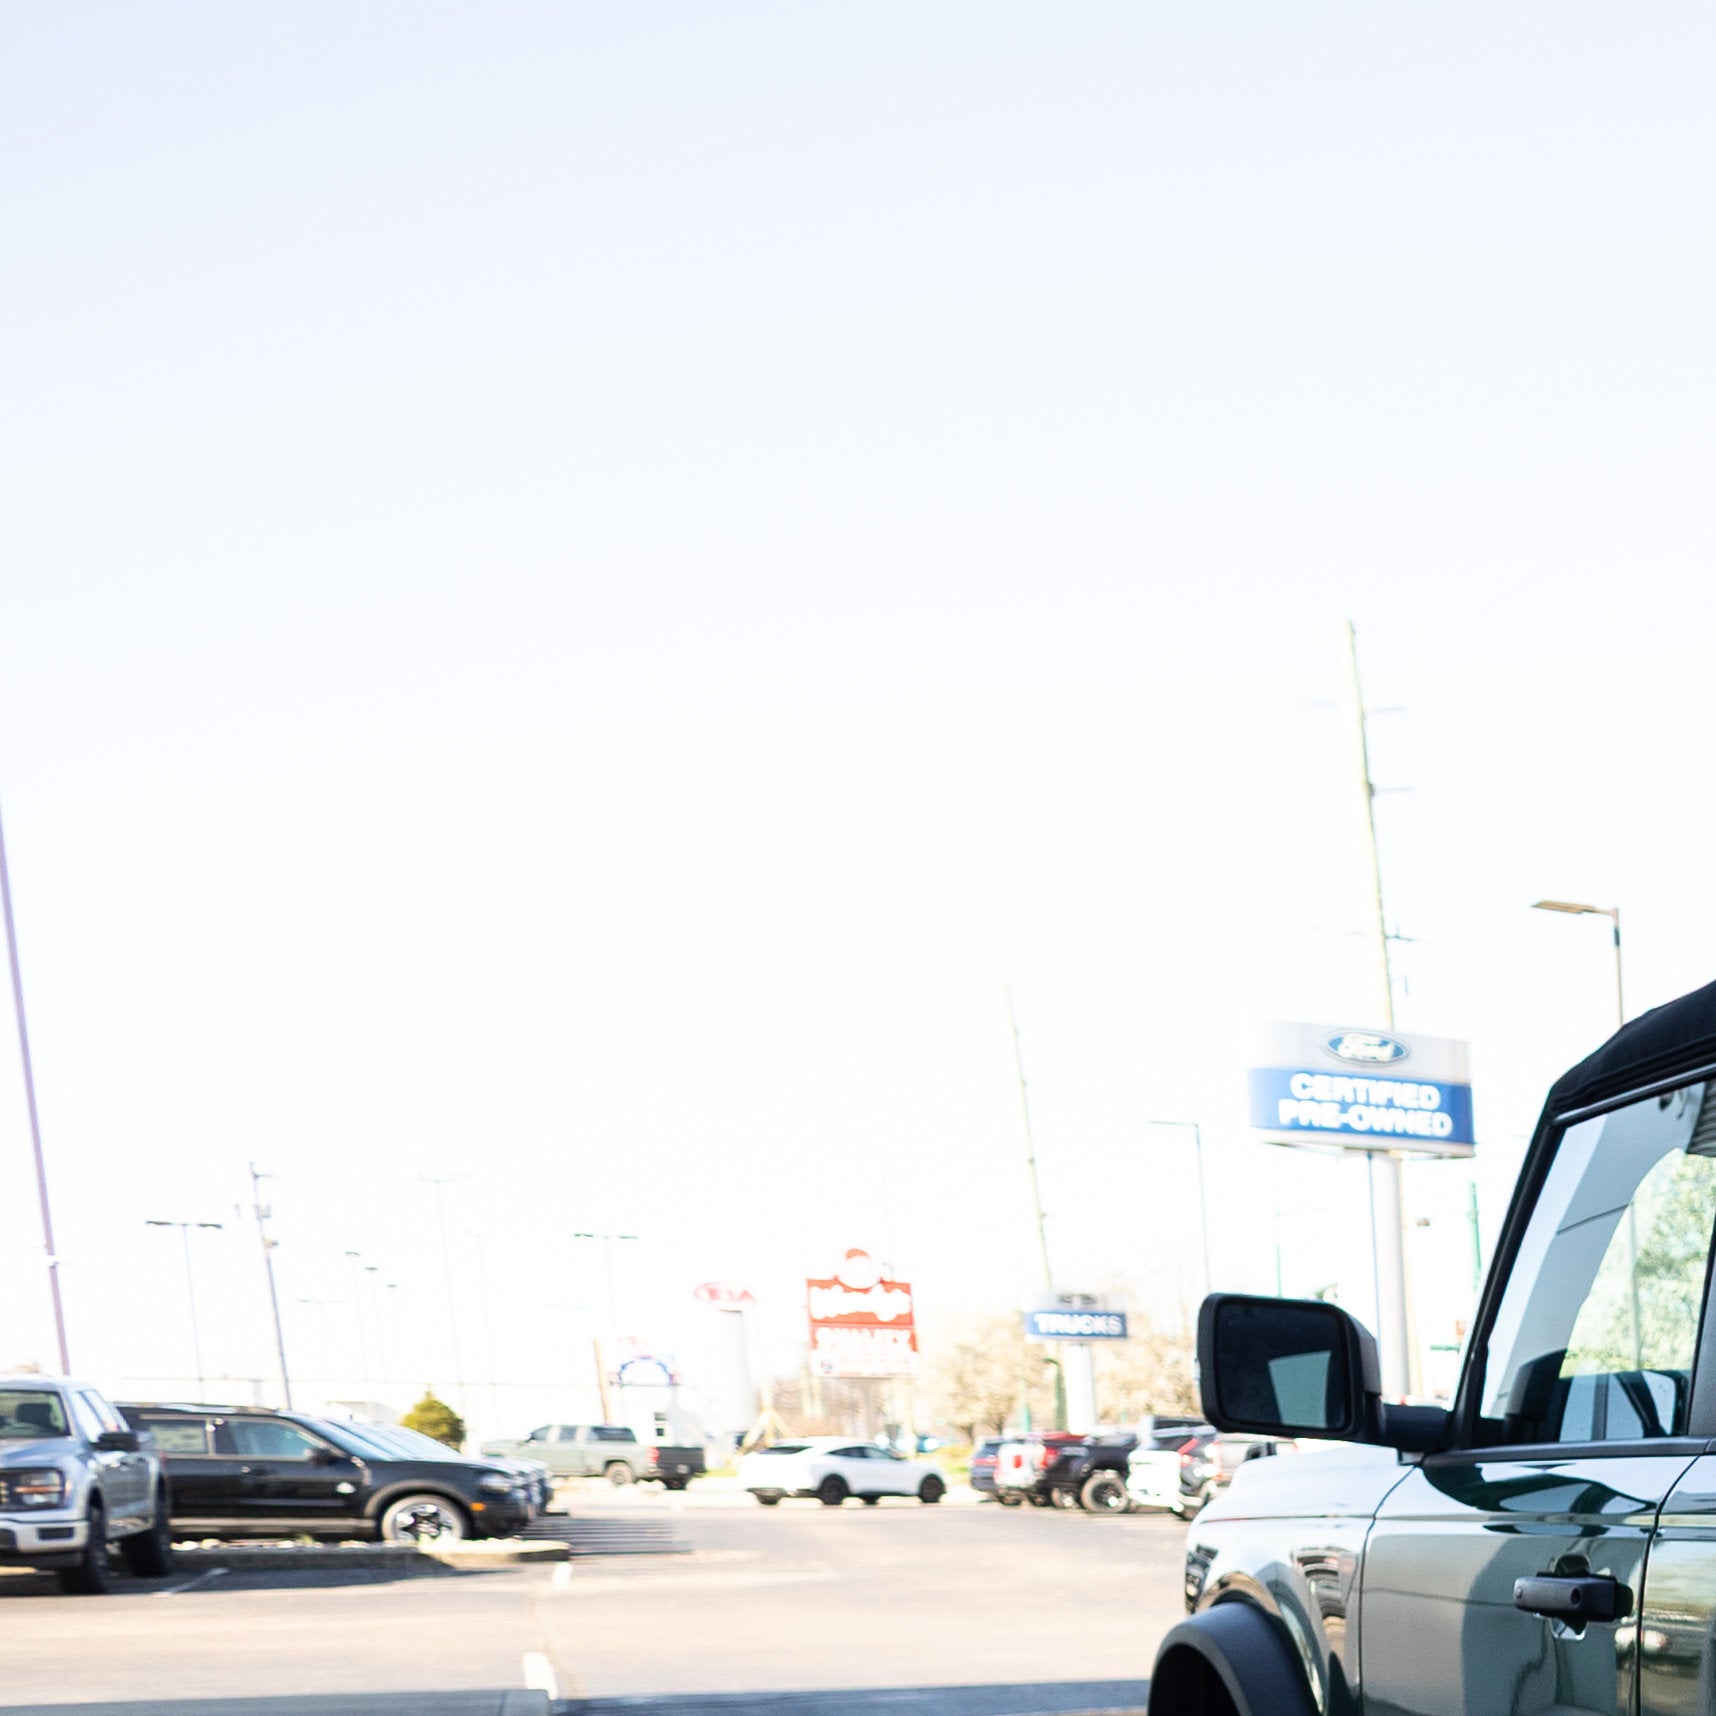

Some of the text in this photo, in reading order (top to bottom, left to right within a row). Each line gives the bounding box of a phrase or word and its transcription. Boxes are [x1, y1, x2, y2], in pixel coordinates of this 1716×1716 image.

[1289, 1073, 1441, 1110] CERTIFIED
[1278, 1099, 1453, 1137] PRE-OWNED
[1032, 1312, 1122, 1336] TRUCKS
